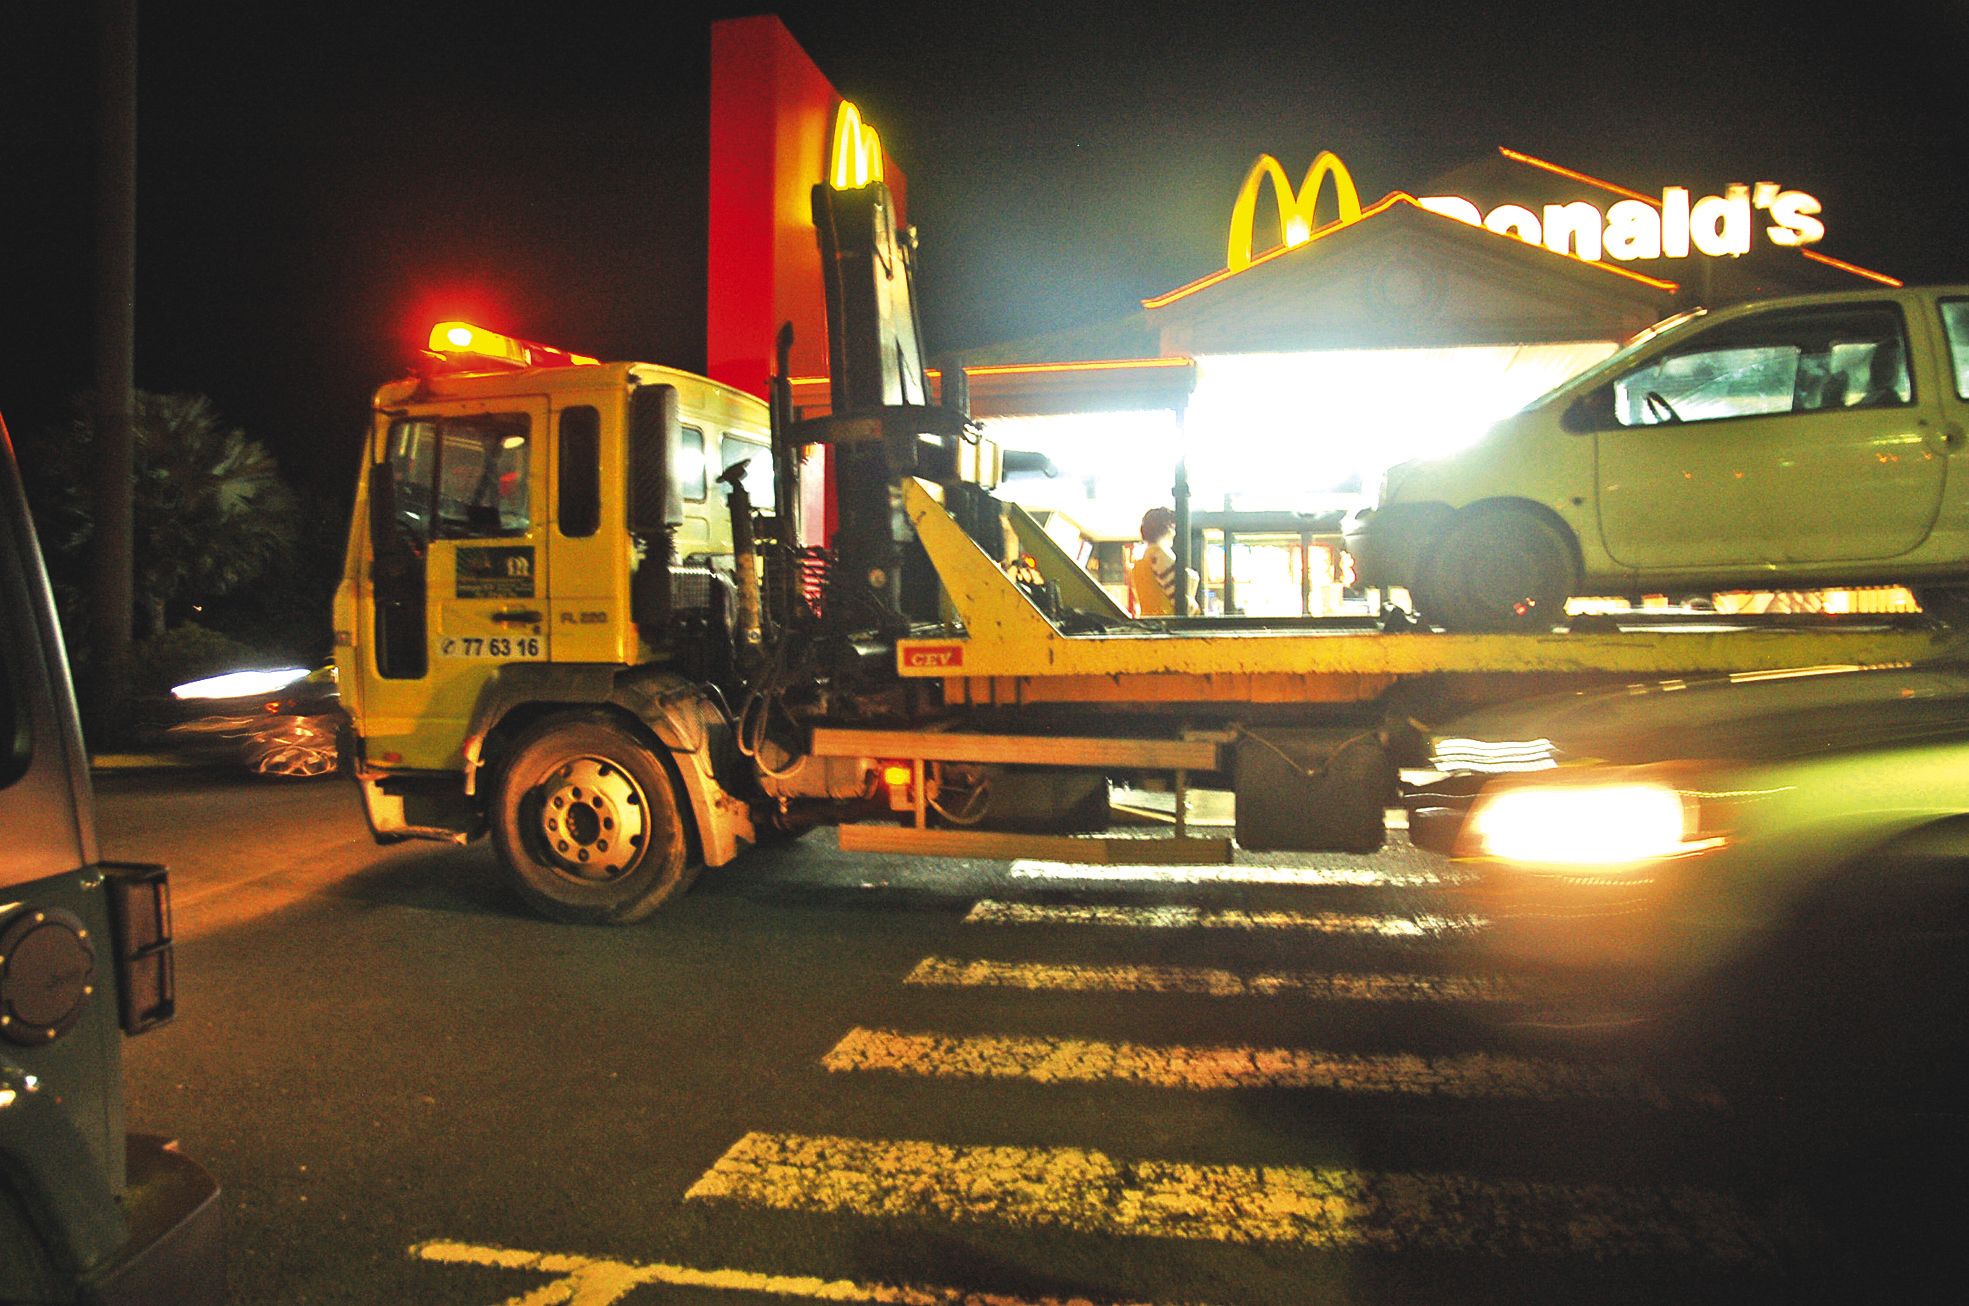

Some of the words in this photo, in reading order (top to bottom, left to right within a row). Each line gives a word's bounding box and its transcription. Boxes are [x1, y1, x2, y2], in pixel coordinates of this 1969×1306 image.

[462, 638, 484, 657] 77
[489, 638, 511, 657] 63
[517, 638, 539, 657] 16
